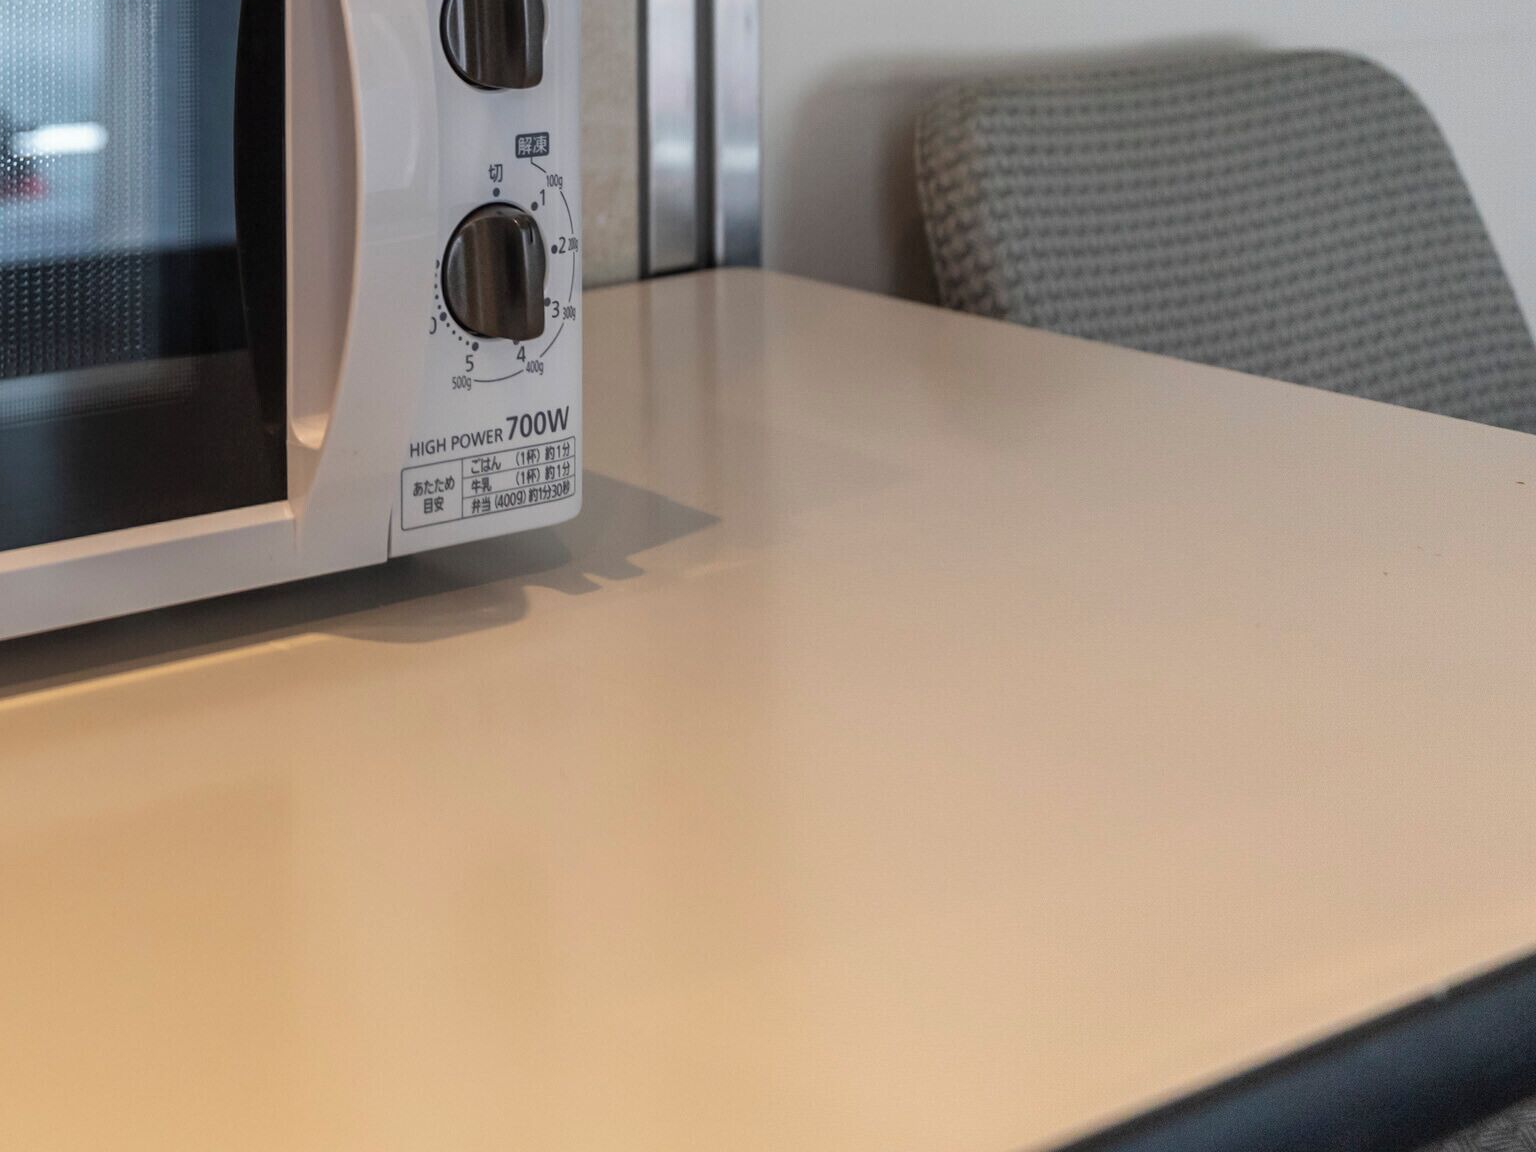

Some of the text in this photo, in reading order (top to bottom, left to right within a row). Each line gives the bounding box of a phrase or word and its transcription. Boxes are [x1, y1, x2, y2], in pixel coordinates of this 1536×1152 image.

[517, 135, 548, 155] 解凍
[488, 163, 504, 184] 切
[546, 174, 563, 189] 100g
[539, 189, 546, 206] 1
[551, 300, 561, 318] 3
[516, 345, 526, 362] 4
[465, 354, 475, 372] 5
[525, 359, 544, 375] 400g
[409, 405, 570, 459] HIGH POWER 700W
[471, 456, 502, 474] ごはん
[413, 475, 455, 497] あたため
[471, 478, 492, 494] 牛乳
[423, 497, 445, 514] 目安
[471, 498, 492, 514] 弁当
